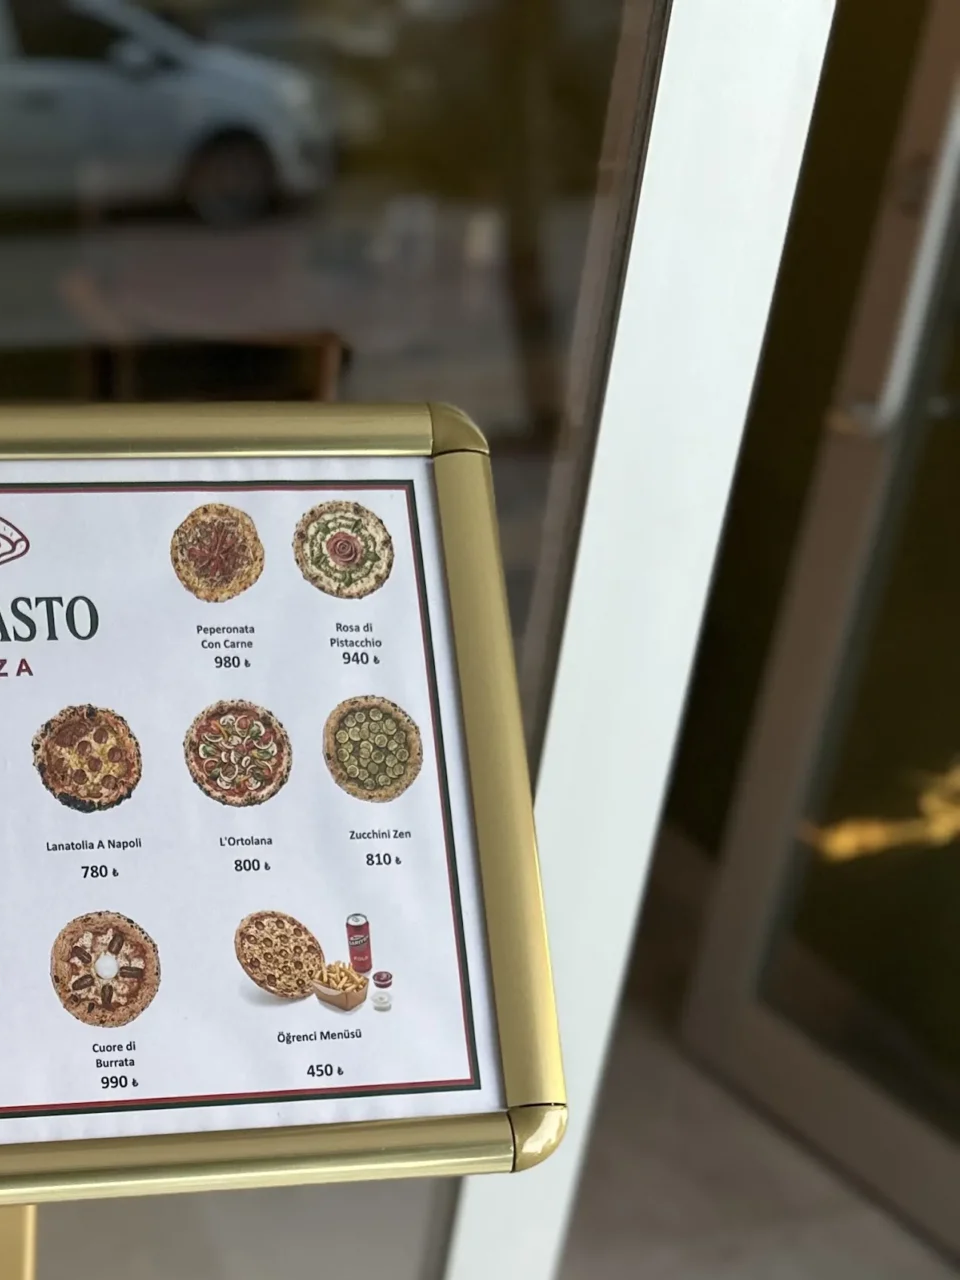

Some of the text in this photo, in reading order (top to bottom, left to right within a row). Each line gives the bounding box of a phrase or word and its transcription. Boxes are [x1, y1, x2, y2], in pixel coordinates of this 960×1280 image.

[197, 625, 255, 636] Peperonata
[336, 623, 373, 632] Rosa di
[201, 639, 253, 649] Con Carne
[330, 637, 382, 647] Pistacchio
[214, 656, 240, 668] 980
[342, 652, 369, 664] 940
[220, 836, 272, 846] L'Ortolana
[349, 830, 411, 840] Zucchini Zen
[46, 838, 141, 851] Lanatolia A Napoli
[234, 859, 260, 872] 800
[366, 853, 392, 866] 810
[81, 865, 108, 878] 780
[277, 1029, 362, 1044] Öğrenci Menüsü
[92, 1041, 136, 1053] Cuore di
[96, 1058, 135, 1068] Burrata
[307, 1064, 333, 1077] 450
[101, 1075, 128, 1089] 990
